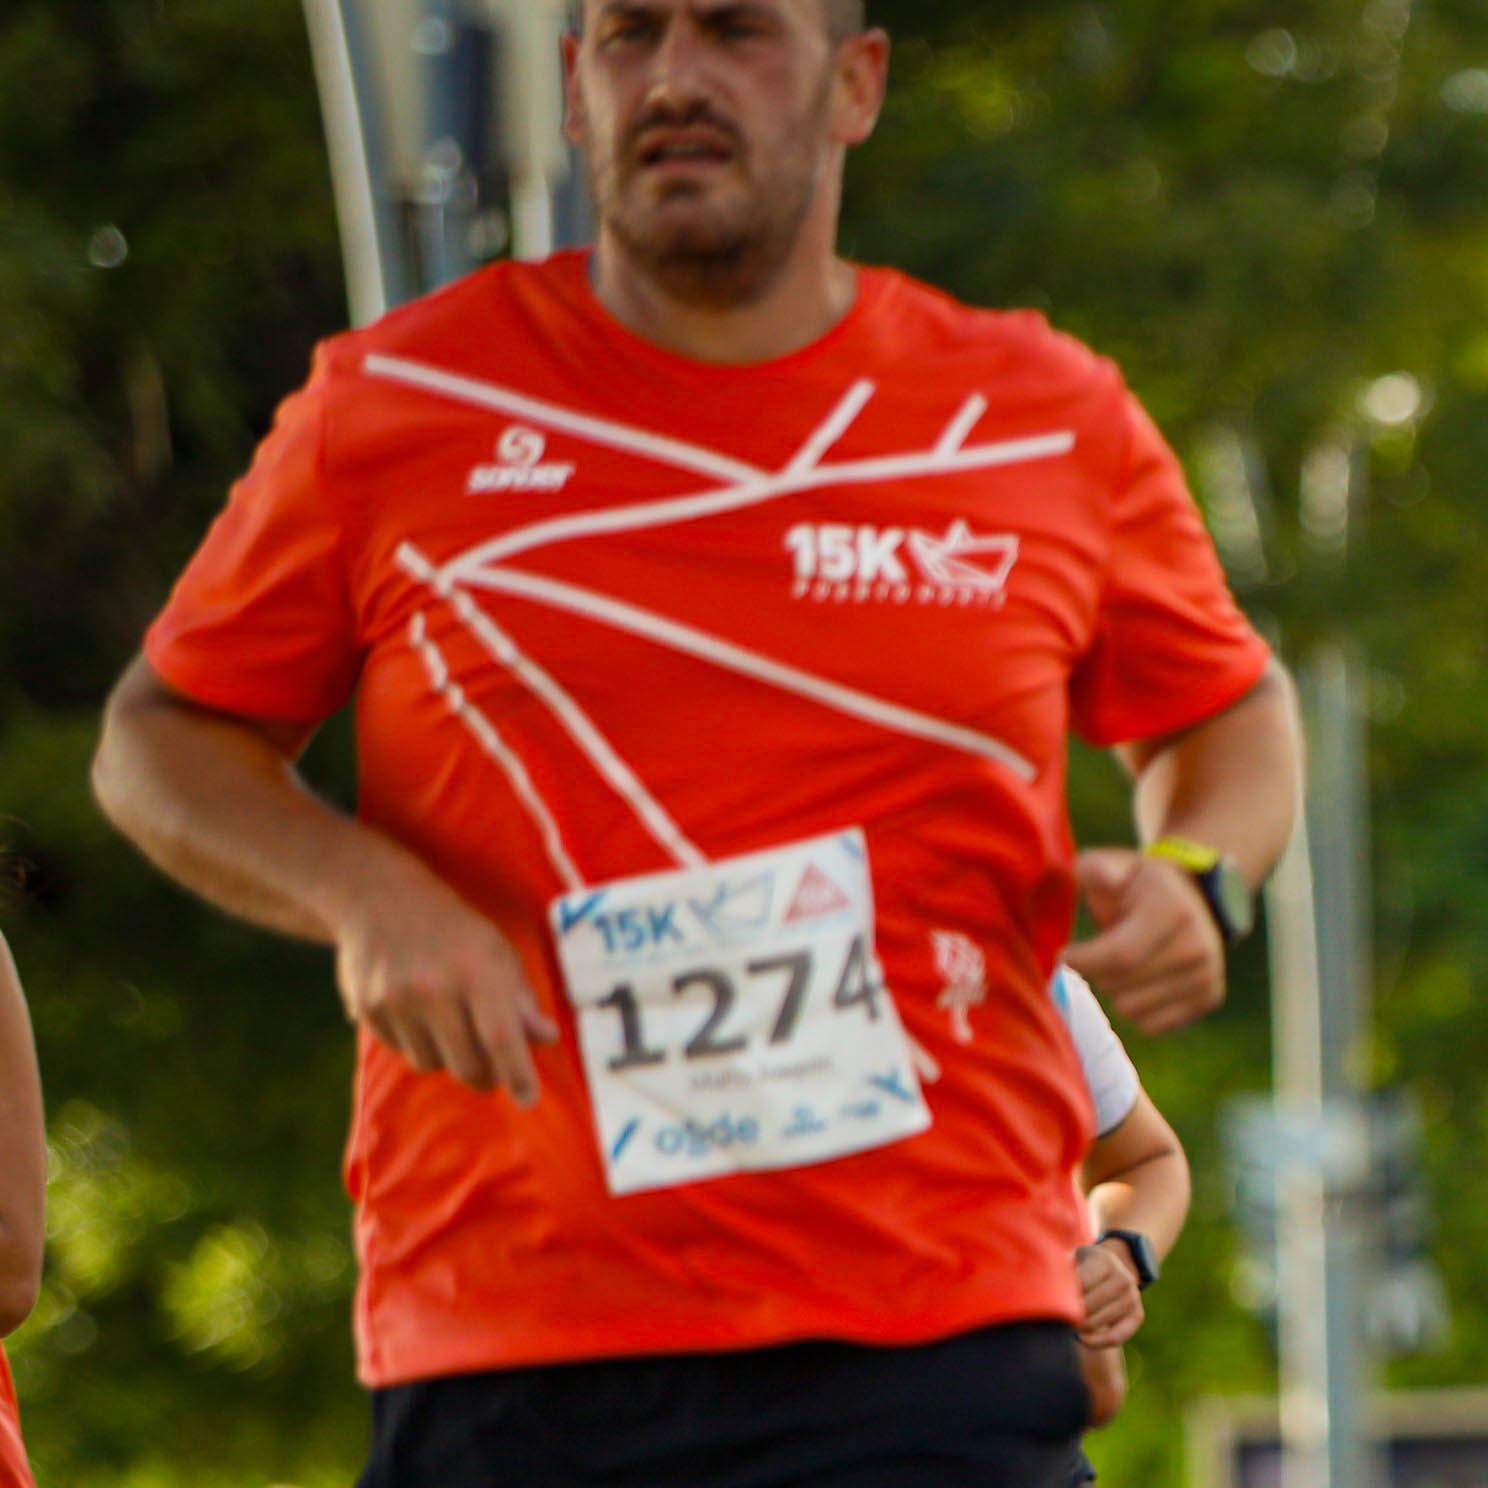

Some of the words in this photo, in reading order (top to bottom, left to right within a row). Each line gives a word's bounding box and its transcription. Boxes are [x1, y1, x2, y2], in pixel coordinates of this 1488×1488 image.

[785, 523, 909, 582] 15K
[592, 902, 685, 953] 15K
[597, 931, 881, 1073] 1274
